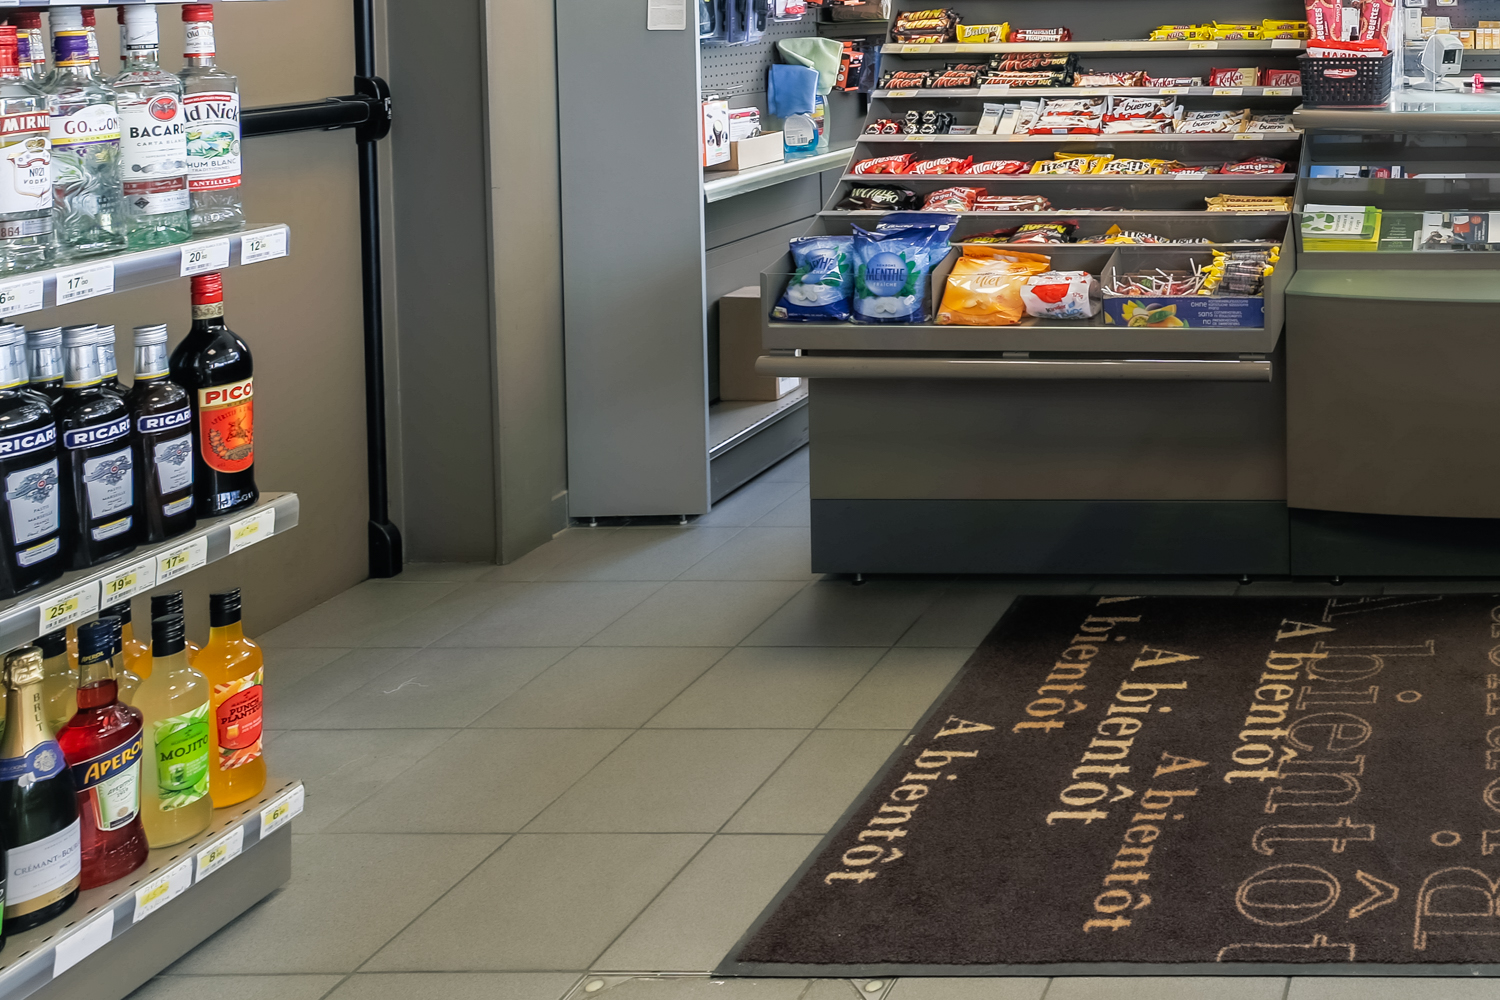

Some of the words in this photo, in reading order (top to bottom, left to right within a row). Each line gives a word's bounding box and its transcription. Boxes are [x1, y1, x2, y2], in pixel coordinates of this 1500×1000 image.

[964, 25, 998, 37] Balisto
[885, 78, 923, 89] Mars
[931, 77, 971, 88] Mars
[1218, 71, 1244, 86] KitKat
[1274, 75, 1300, 87] KitKat
[203, 103, 239, 122] Nick
[1125, 101, 1152, 112] bueno
[1195, 111, 1221, 119] bueno
[129, 122, 185, 139] BACARD
[1192, 119, 1218, 127] bueno
[211, 157, 236, 167] BLANC
[192, 177, 232, 187] ANTILLES
[865, 268, 905, 282] MENTHE
[973, 275, 1001, 287] Miel
[205, 384, 253, 405] PICO
[1275, 618, 1336, 643] A
[1131, 645, 1200, 671] A
[1012, 613, 1142, 733] bientôt
[33, 692, 44, 732] BRUT
[1224, 650, 1329, 784] bientôt
[934, 714, 996, 740] A
[160, 734, 209, 762] MOJITO
[1046, 681, 1188, 826] bientôt
[84, 740, 143, 785] APEROL
[1154, 751, 1209, 778] A
[825, 749, 980, 885] bientôt
[13, 854, 58, 877] CRÉMANT
[1083, 787, 1199, 933] bientôt
